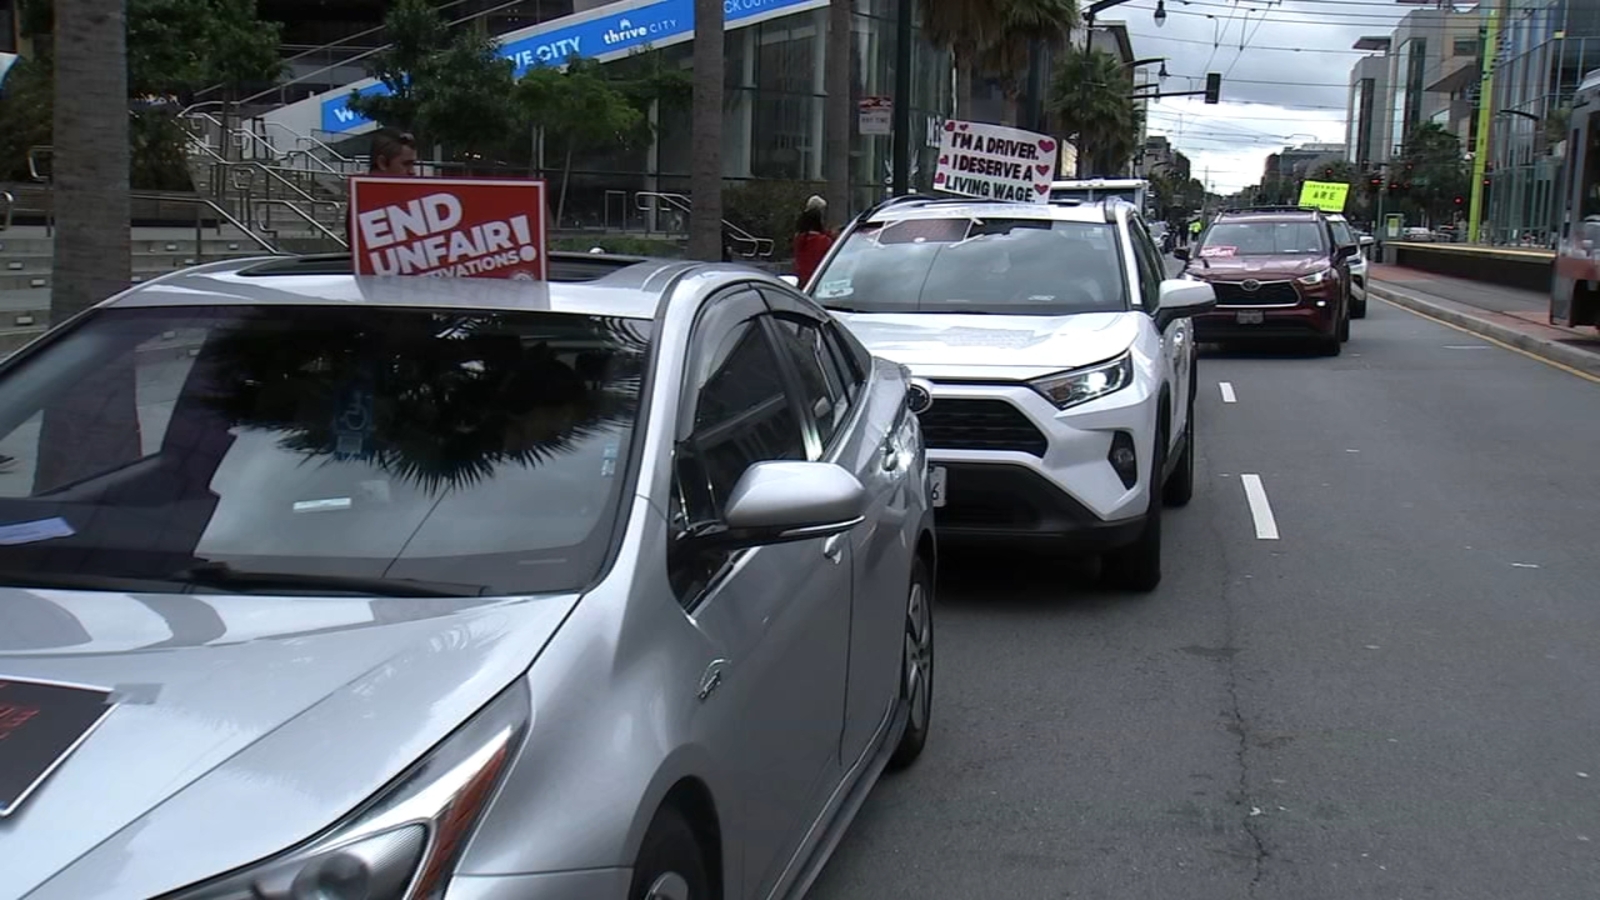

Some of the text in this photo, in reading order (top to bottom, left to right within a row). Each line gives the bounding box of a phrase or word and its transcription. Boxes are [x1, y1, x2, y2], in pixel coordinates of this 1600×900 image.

[604, 19, 677, 45] thrive CITY
[536, 36, 581, 61] CITY
[952, 132, 1039, 160] I'M A DRIVER.
[952, 154, 1033, 182] I DESERVE A
[945, 175, 1036, 203] LIVING WAGE.
[358, 192, 463, 250] END
[369, 215, 537, 276] UNFAIR!
